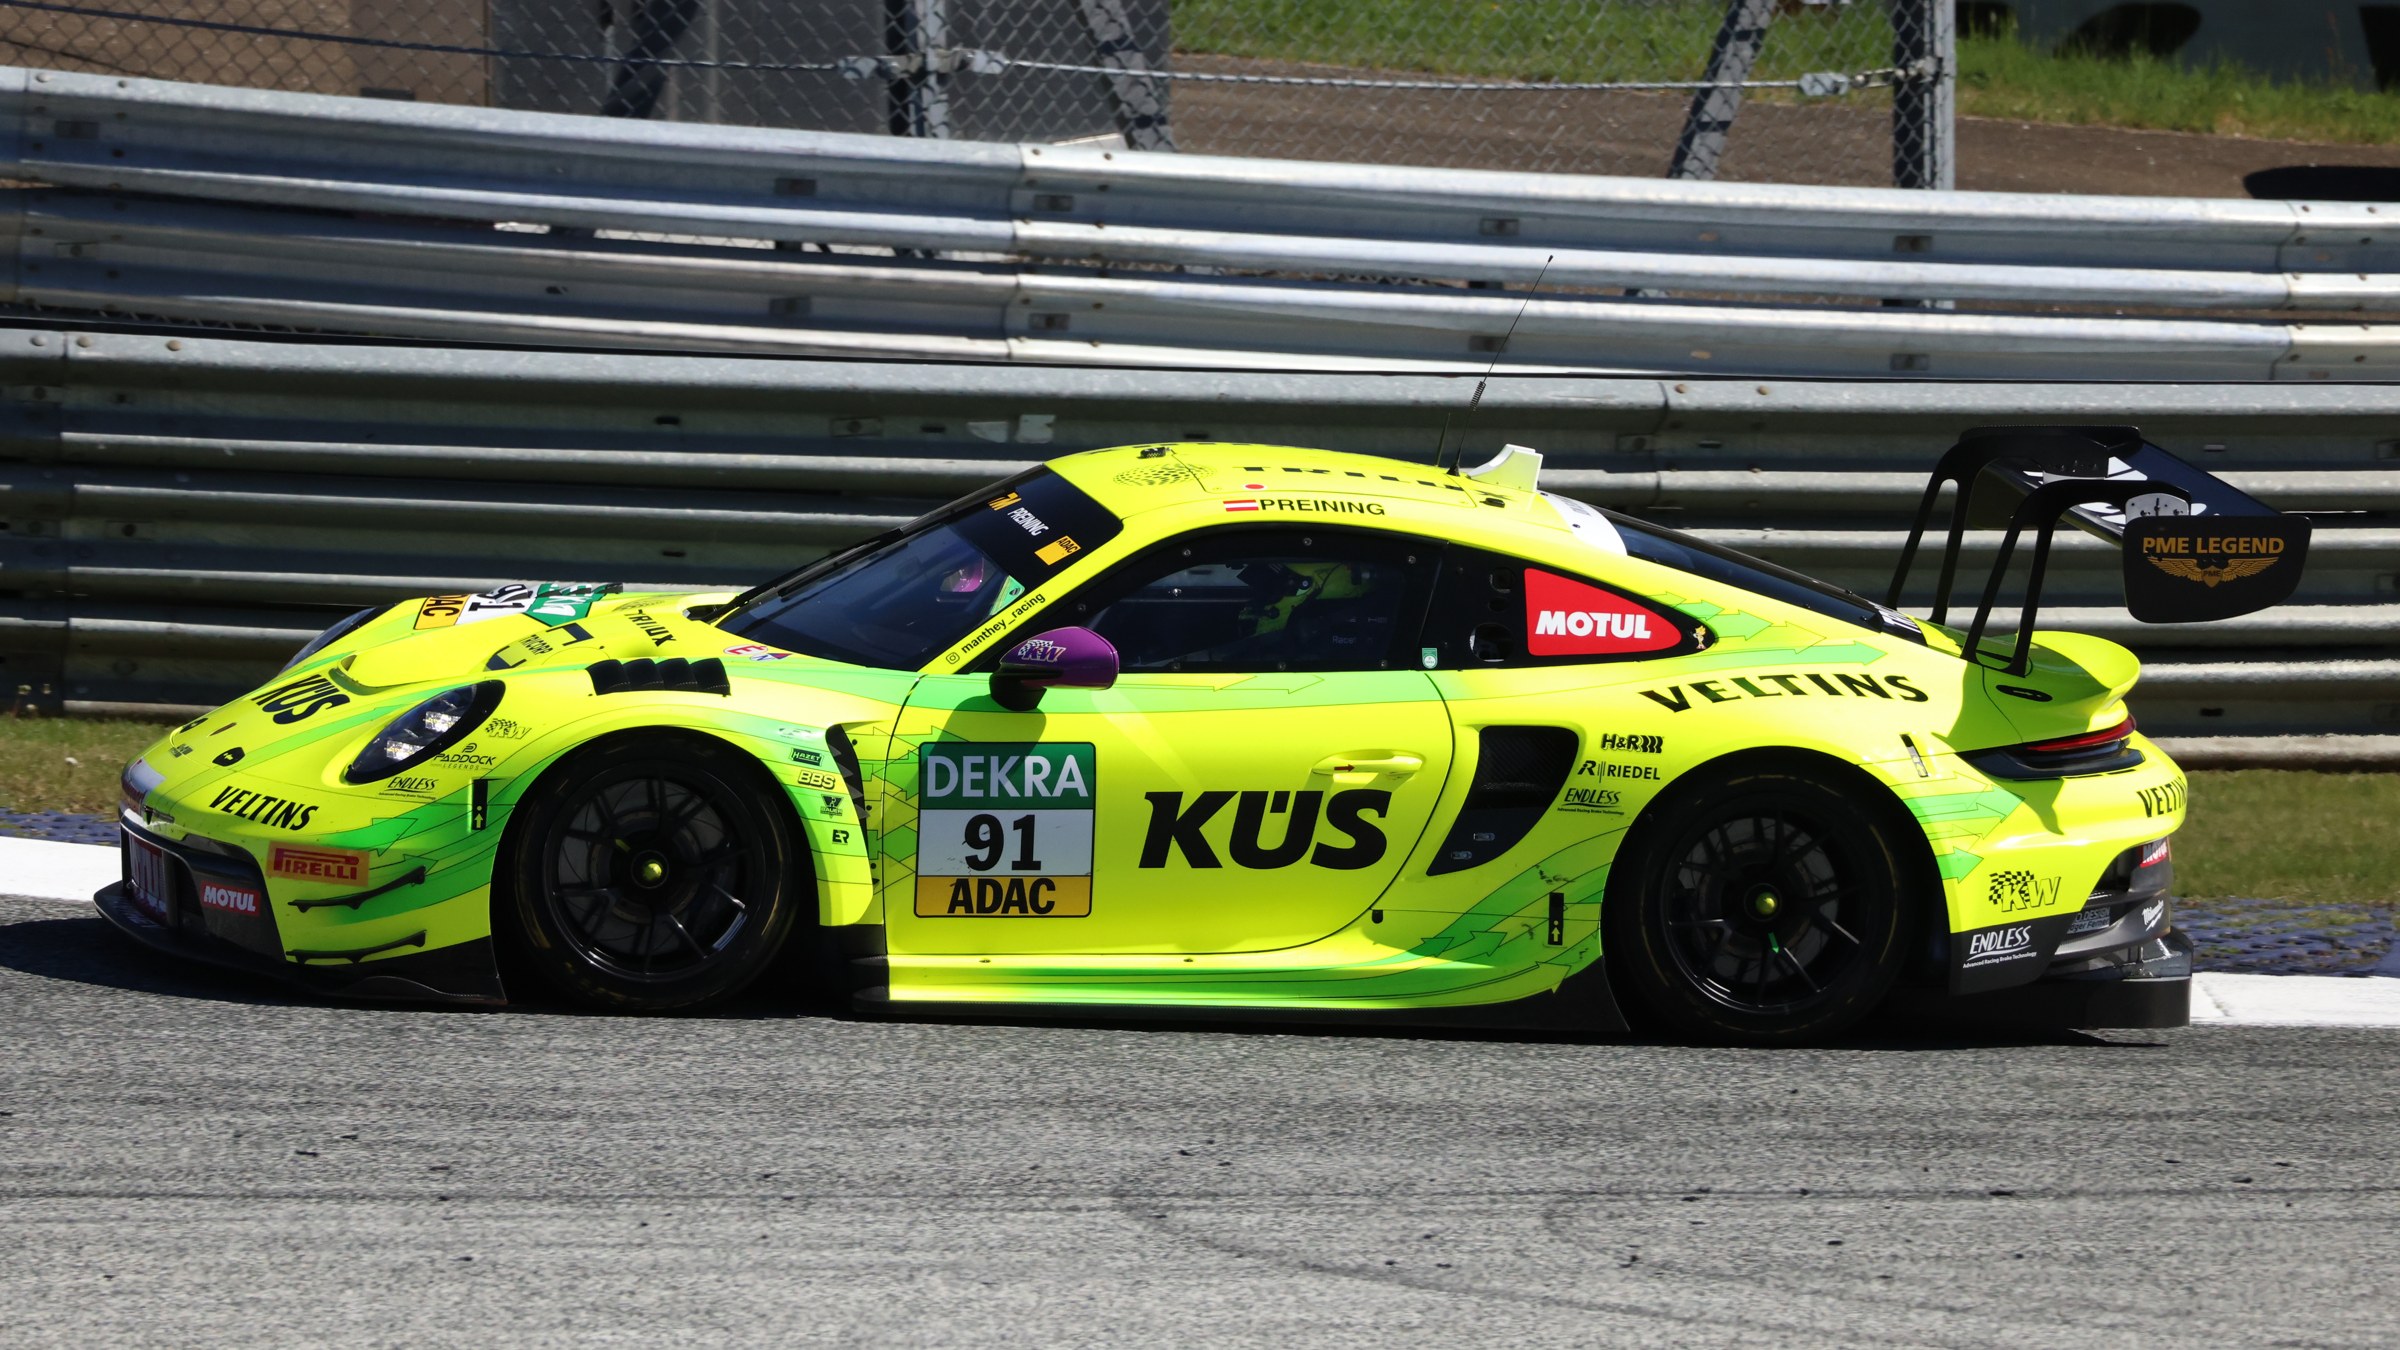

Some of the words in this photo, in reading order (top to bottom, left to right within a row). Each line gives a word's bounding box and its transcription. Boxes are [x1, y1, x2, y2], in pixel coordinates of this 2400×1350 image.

[1006, 506, 1050, 537] PREINING
[1258, 498, 1386, 516] PREINING
[1056, 537, 1079, 554] ADAC
[2143, 537, 2190, 554] PME
[2195, 537, 2286, 554] LEGEND
[623, 608, 677, 648] TRILUX
[959, 592, 1047, 655] manthey_racing
[1534, 609, 1653, 640] MOTUL
[1021, 644, 1067, 662] KW
[250, 673, 351, 725] KÜS
[1639, 672, 1930, 714] VELTINS
[489, 723, 533, 740] KW
[1601, 733, 1642, 753] H&R
[433, 752, 497, 766] PADDOCK
[442, 763, 480, 771] LEGENDS
[792, 751, 821, 762] HAZET
[387, 776, 440, 791] ENDLESS
[797, 770, 836, 790] BBS
[926, 754, 1089, 798] DEKRA
[1607, 764, 1661, 781] RIEDEL
[208, 785, 320, 832] VELTINS
[1564, 787, 1622, 805] ENDLESS
[962, 812, 1043, 872] 91
[1138, 788, 1393, 870] KÜS
[273, 847, 360, 880] PIRELLI
[202, 884, 257, 913] MOTUL
[946, 877, 1057, 915] ADAC
[2000, 875, 2062, 912] KW
[1969, 925, 2032, 955] ENDLESS
[1962, 959, 1984, 969] Advanced
[1984, 956, 1999, 966] Racing
[1999, 954, 2012, 964] Brake
[2012, 951, 2038, 963] Technology
